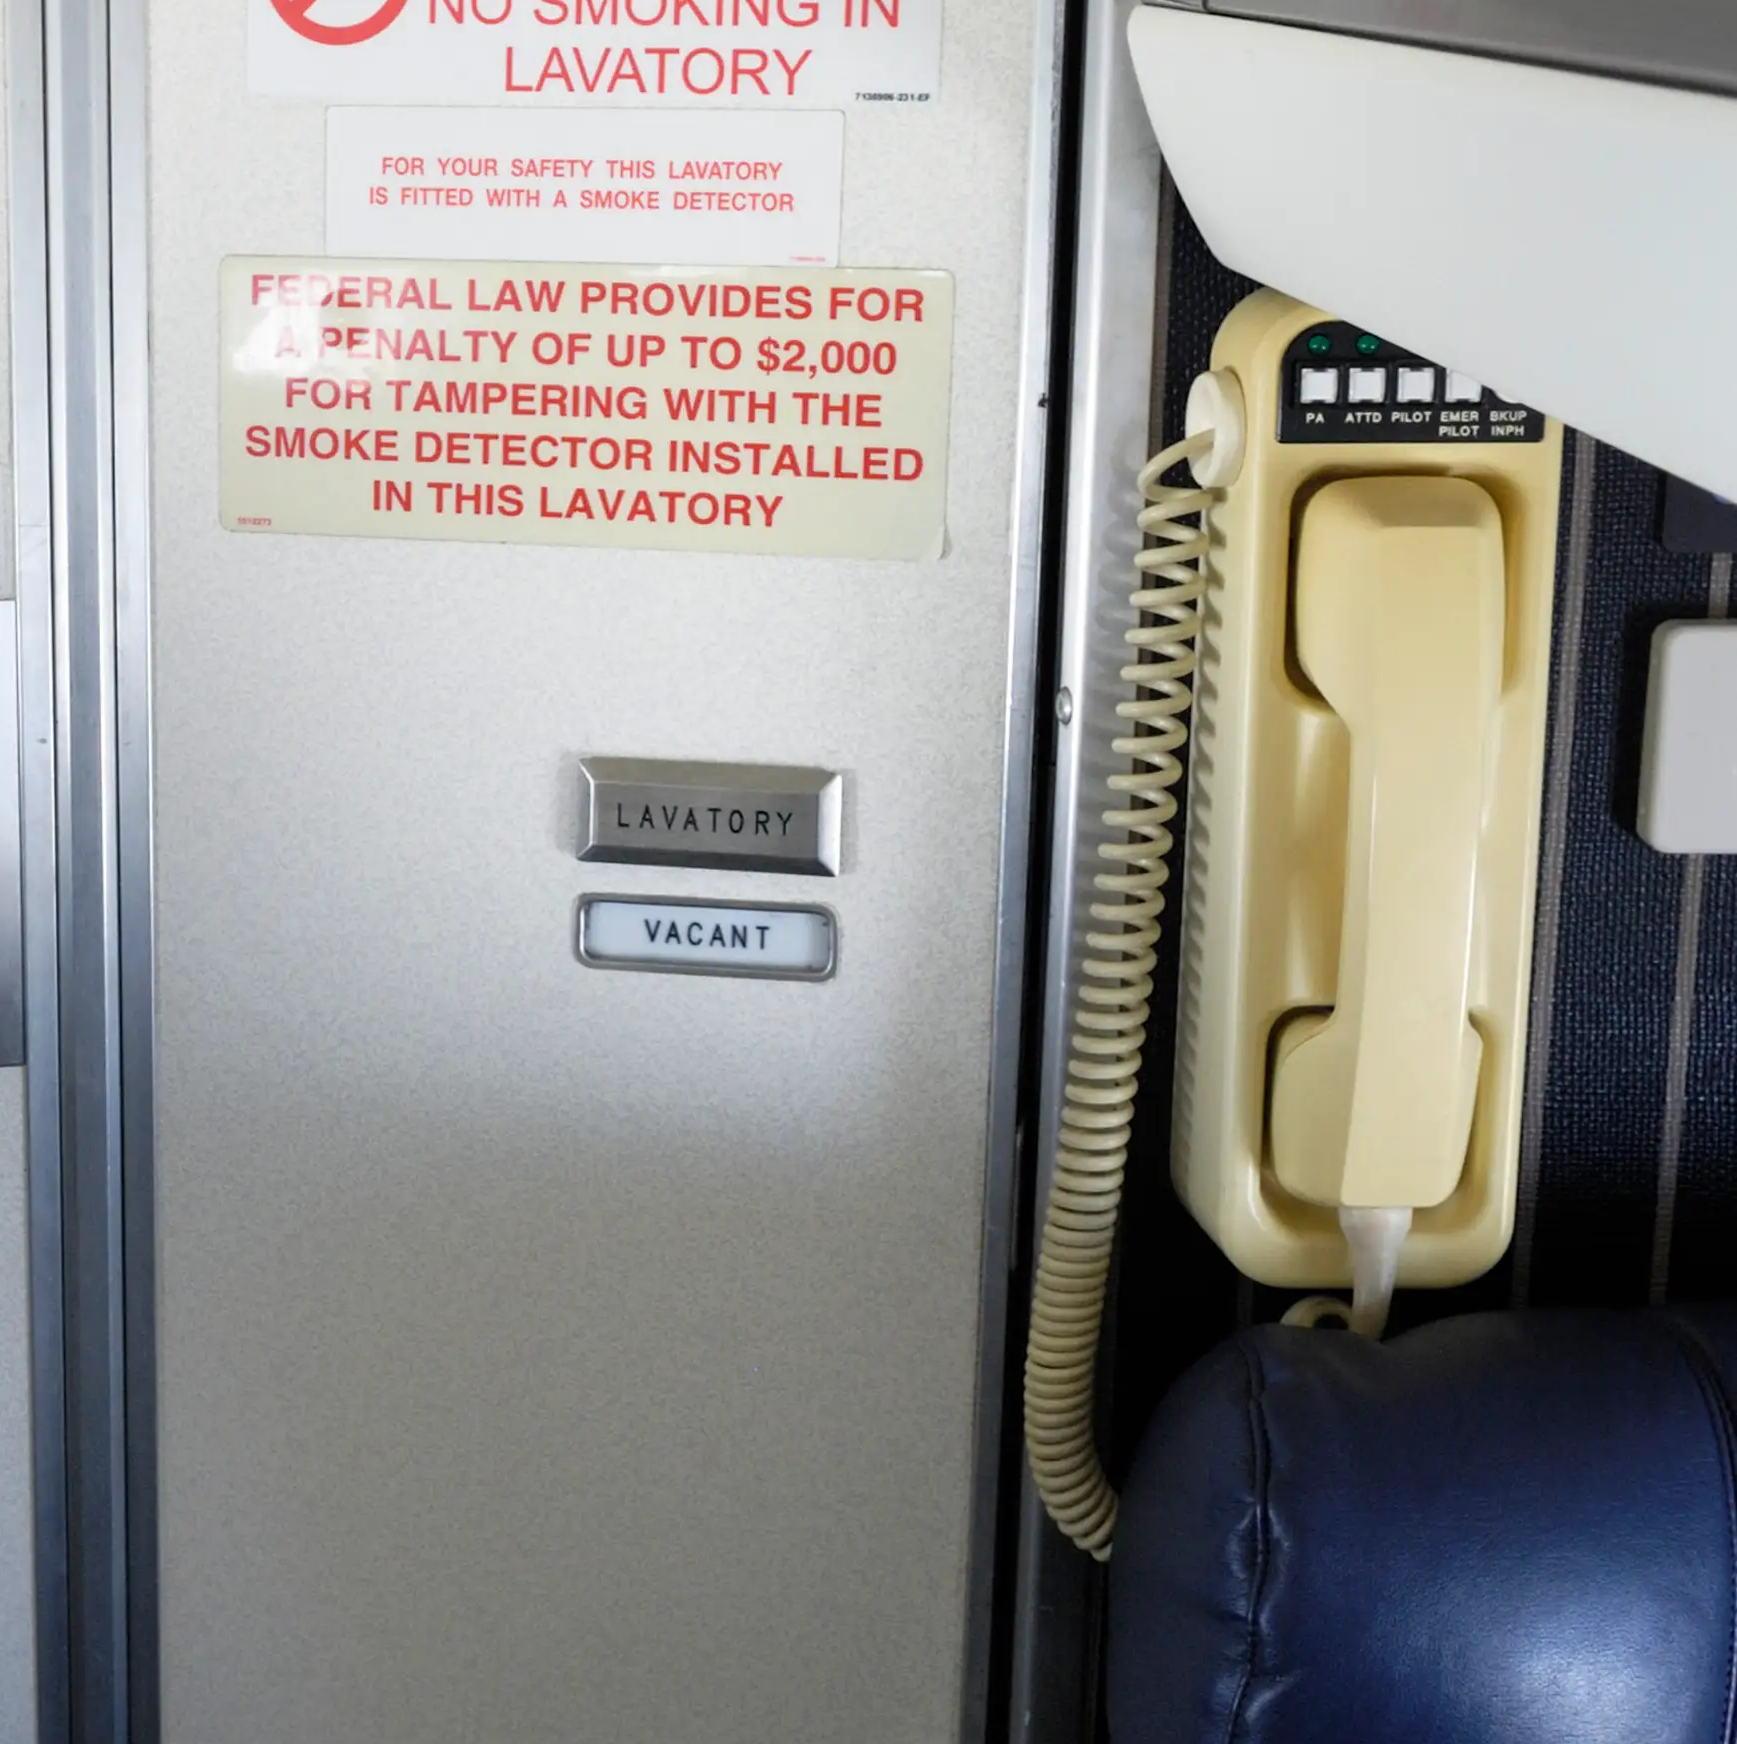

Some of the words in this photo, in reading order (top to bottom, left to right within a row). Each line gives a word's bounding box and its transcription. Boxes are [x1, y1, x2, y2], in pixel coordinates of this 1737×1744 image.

[504, 46, 813, 96] LAVATORY
[382, 157, 424, 178] FOR
[437, 157, 499, 178] YOUR
[511, 159, 594, 180] SAFETY
[606, 160, 655, 180] THIS
[669, 161, 783, 182] LAVATORY
[369, 187, 388, 206] IS
[400, 188, 474, 207] FITTED
[486, 188, 541, 208] WITH
[553, 190, 567, 209] A
[580, 190, 661, 211] SMOKE
[673, 191, 794, 213] DETECTOR
[251, 274, 452, 311] FEDERAL
[466, 278, 565, 314] LAW
[580, 282, 813, 320] PROVIDES
[828, 287, 924, 322] FOR
[319, 327, 518, 366] PENALTY
[532, 331, 591, 366] OF
[607, 334, 665, 369] UP
[681, 336, 743, 370] TO
[757, 339, 897, 378] $2,000
[285, 377, 372, 410] FOR
[385, 380, 648, 420] TAMPERING
[663, 388, 778, 425] WITH
[793, 392, 882, 428] THE
[1306, 412, 1325, 423] PA
[1344, 412, 1382, 423] ATTD
[1391, 411, 1432, 423] PILOT
[1440, 411, 1479, 422] EMER
[1490, 411, 1527, 422] BKUP
[1439, 425, 1479, 437] PILOT
[1491, 425, 1524, 436] INPH
[245, 425, 398, 462] SMOKE
[415, 432, 654, 472] DETECTOR
[668, 440, 923, 482] INSTALLED
[372, 480, 413, 515] IN
[427, 483, 523, 518] THIS
[539, 487, 784, 528] LAVATORY
[617, 803, 793, 835] LAVATORY
[644, 919, 771, 950] VACANT
